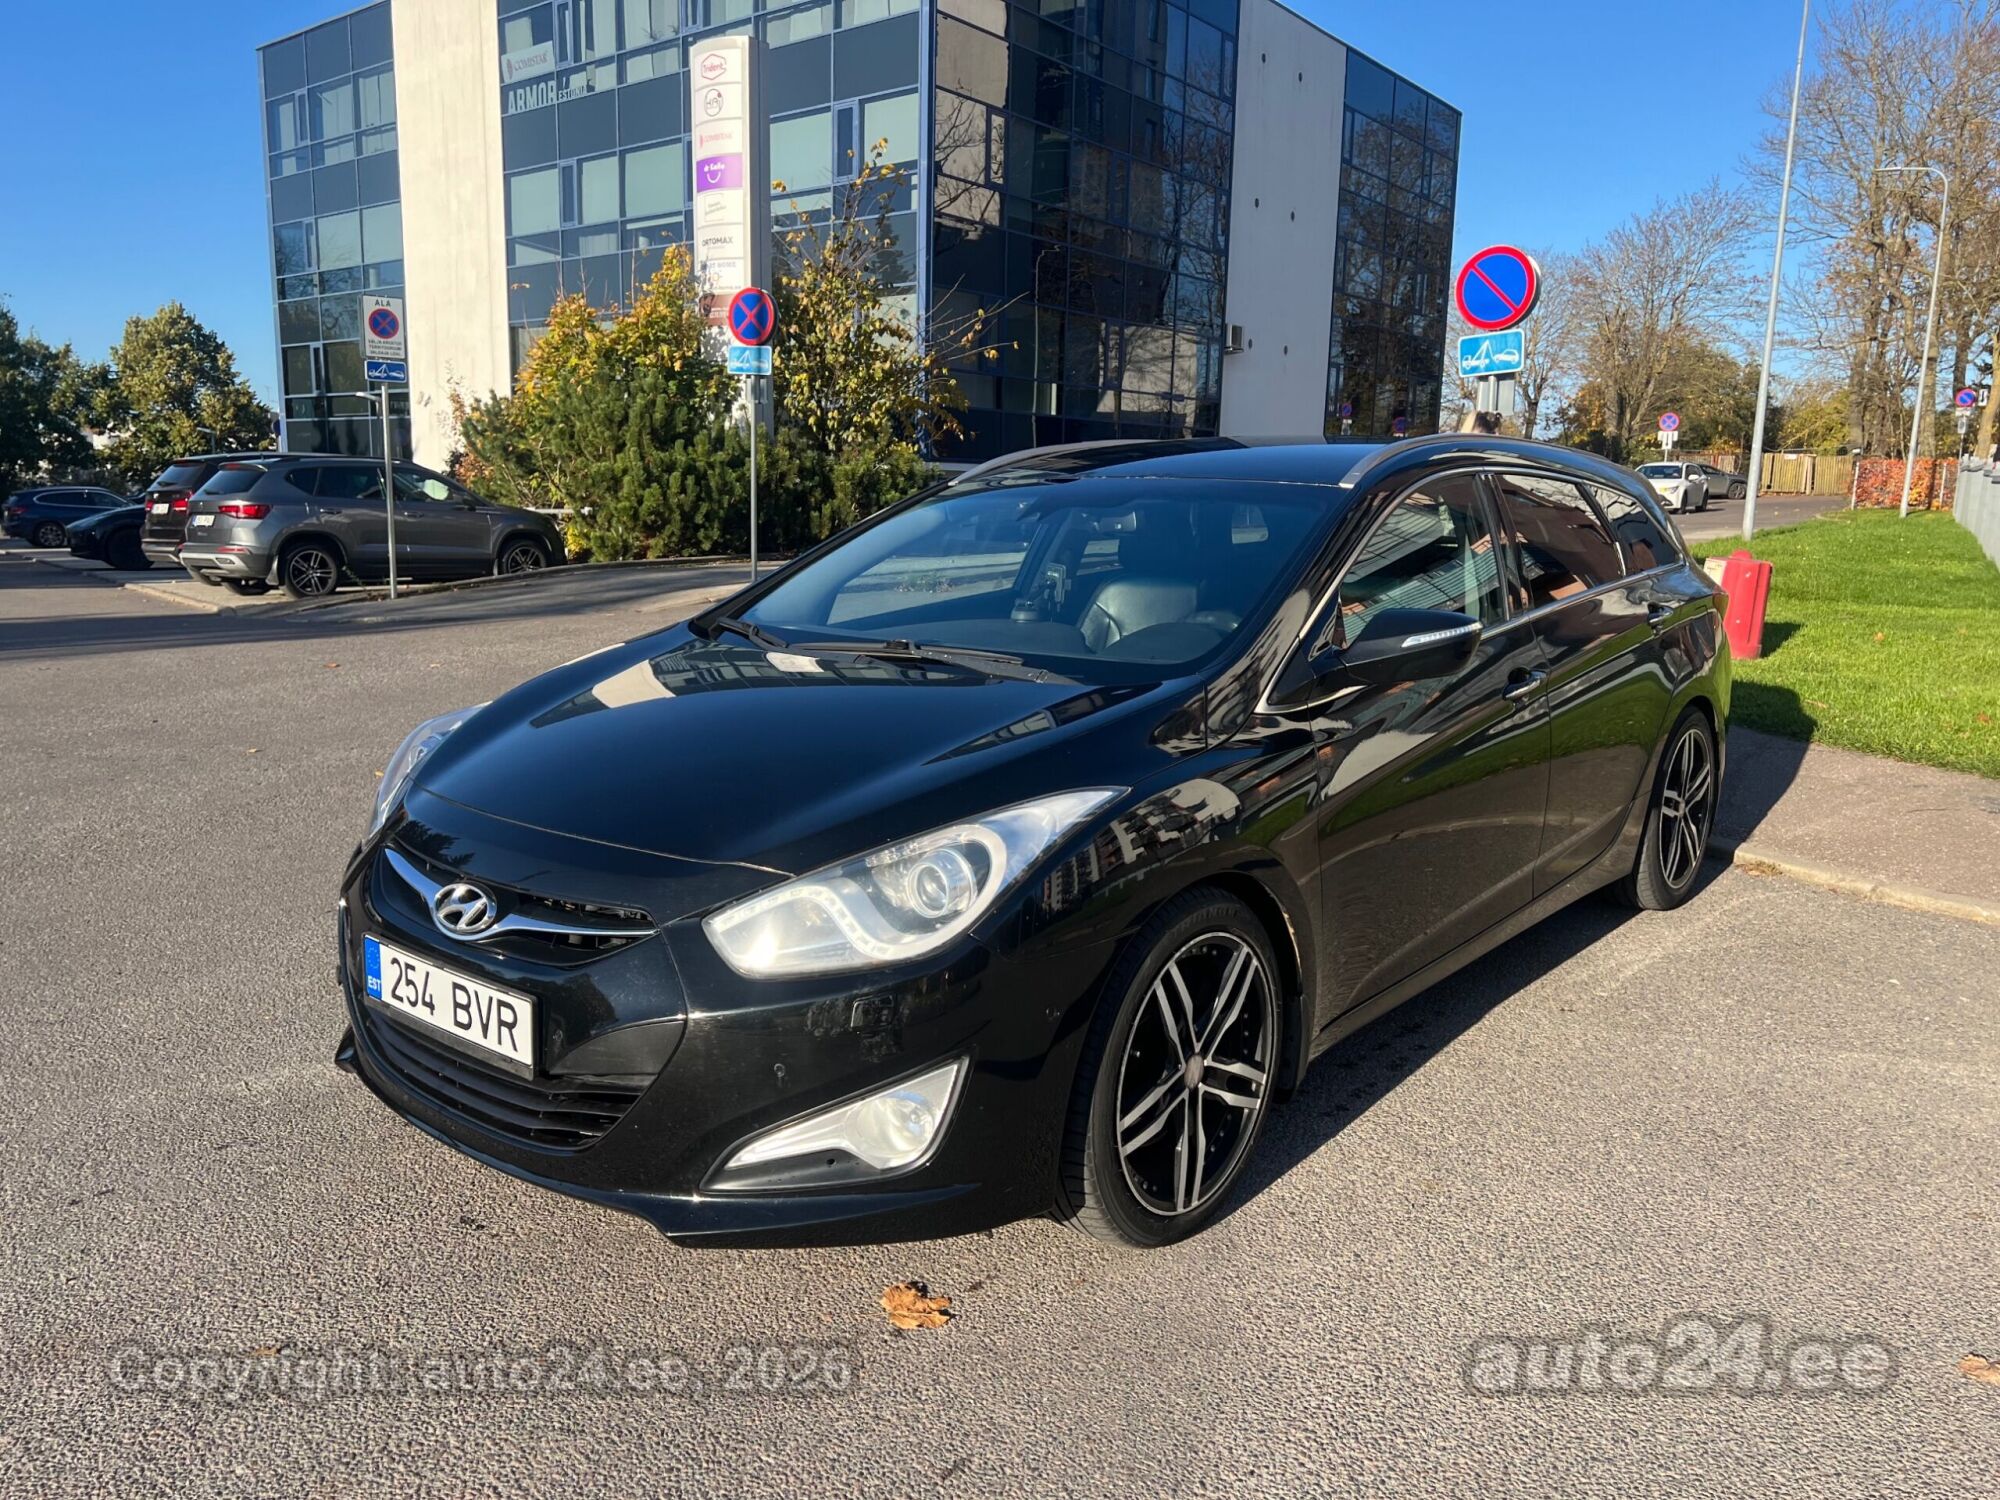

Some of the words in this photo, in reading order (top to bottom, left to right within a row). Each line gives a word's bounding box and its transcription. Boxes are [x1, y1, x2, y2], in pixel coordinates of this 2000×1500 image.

[507, 80, 556, 115] ARMOR
[702, 236, 733, 246] ORTOMAX
[374, 298, 391, 307] ALA
[367, 975, 381, 992] EST
[390, 956, 436, 1016] 254
[451, 980, 519, 1053] BVR
